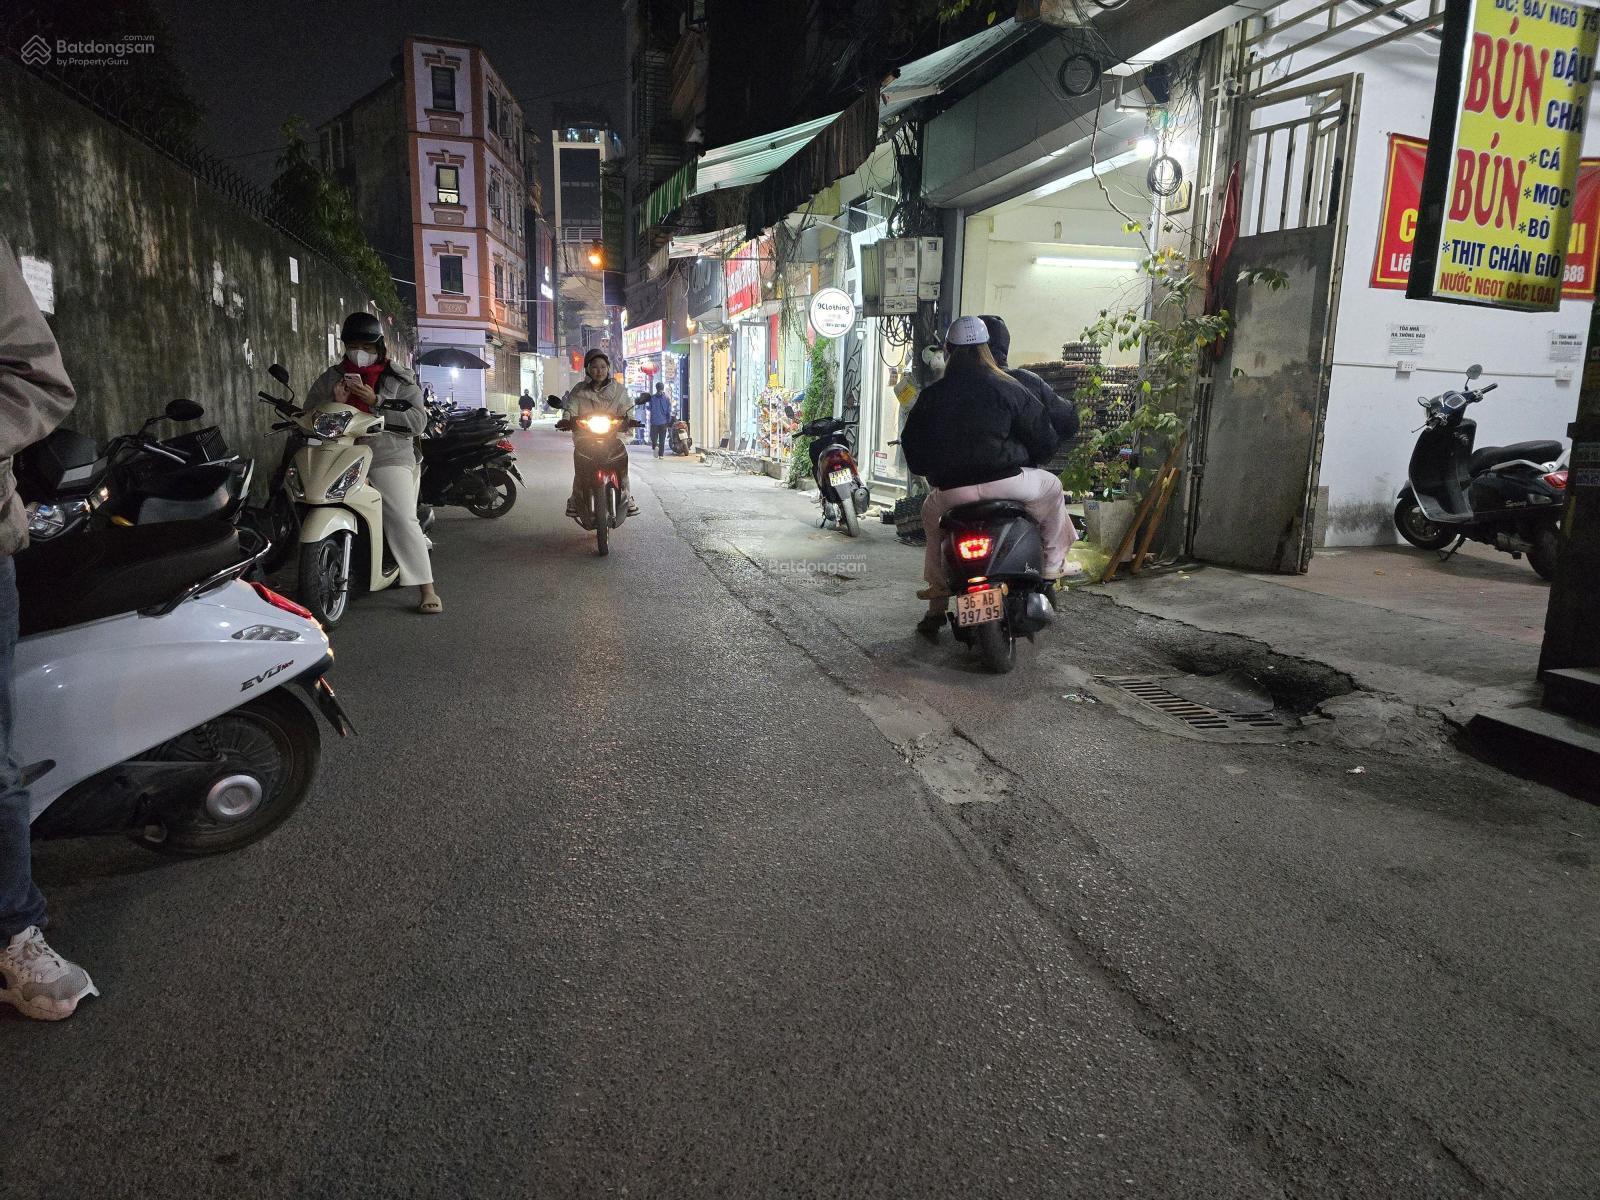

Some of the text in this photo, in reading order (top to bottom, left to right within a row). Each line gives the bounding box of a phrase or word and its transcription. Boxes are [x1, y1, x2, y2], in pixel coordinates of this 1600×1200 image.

[1464, 16, 1592, 126] BÚN ĐẬU
[1449, 132, 1527, 231] BÚN
[1539, 147, 1560, 171] CÁ
[1533, 183, 1571, 210] MỌC
[1528, 216, 1551, 239] BÒ
[1452, 239, 1562, 279] THỊT CHÂN GIÒ
[1440, 271, 1473, 293] NƯỚC
[1474, 276, 1506, 299] NGỌT
[1506, 279, 1530, 299] CÁC
